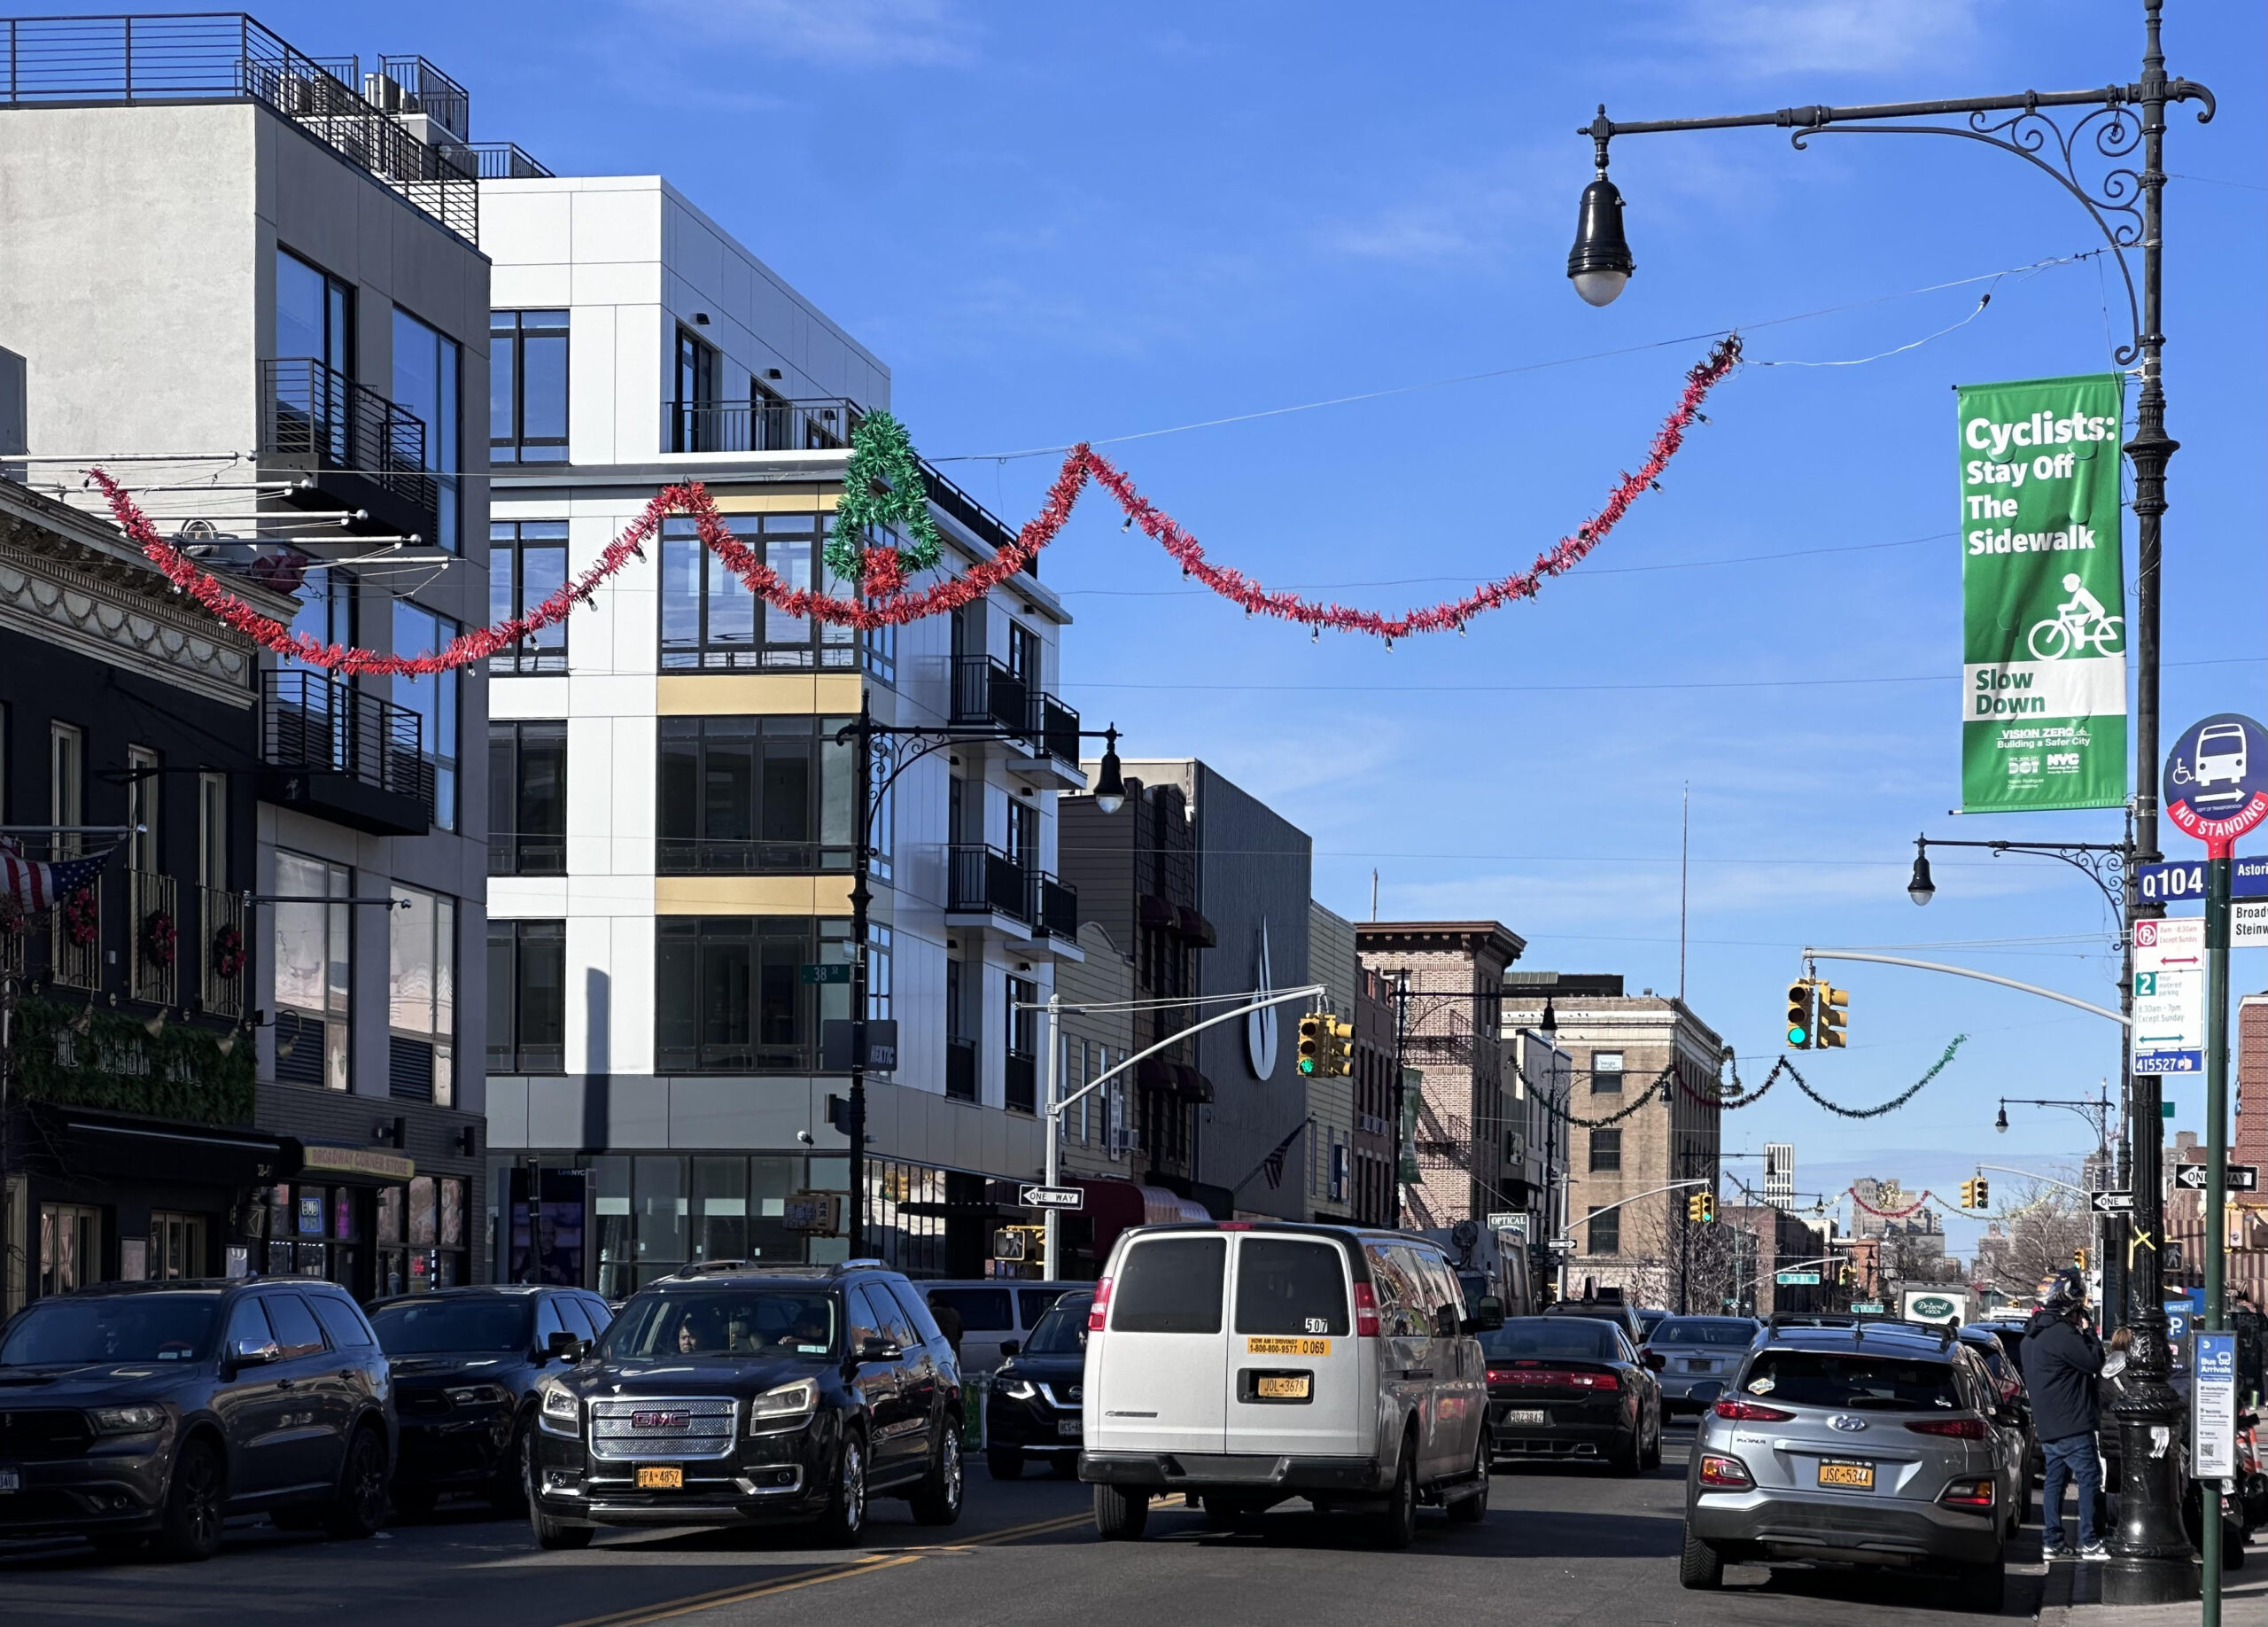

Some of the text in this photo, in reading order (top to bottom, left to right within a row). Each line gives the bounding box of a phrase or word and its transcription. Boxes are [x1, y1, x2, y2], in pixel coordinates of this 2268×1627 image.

[1966, 410, 2116, 455] Cyclists:
[1967, 452, 2075, 487] Stay Off
[1967, 494, 2018, 519] The
[1969, 524, 2096, 556] Sidewalk
[1976, 669, 2033, 690] Slow
[1976, 693, 2045, 715] Down
[2001, 727, 2074, 739] VISION ZERO
[1997, 739, 2035, 749] Building
[2045, 737, 2070, 747] Safer
[2071, 736, 2090, 746] City
[2047, 753, 2079, 766] NYC
[2008, 761, 2039, 775] DOT
[2175, 798, 2266, 837] NO STANDING
[2143, 868, 2203, 898] Q104
[2236, 907, 2268, 918] Broad
[813, 967, 827, 982] 38
[2140, 974, 2151, 994] 2
[2168, 1004, 2181, 1013] 7pm
[2161, 1014, 2185, 1023] Sunday
[2136, 1058, 2177, 1071] 415527
[312, 1149, 408, 1175] BROADWAY CORNER STORE
[2227, 1174, 2246, 1183] AY
[301, 1201, 319, 1216] BUD
[1305, 1318, 1328, 1333] 507
[1249, 1344, 1298, 1353] 1-800-800-9577
[1309, 1342, 1324, 1354] 069
[633, 1412, 689, 1426] GMC
